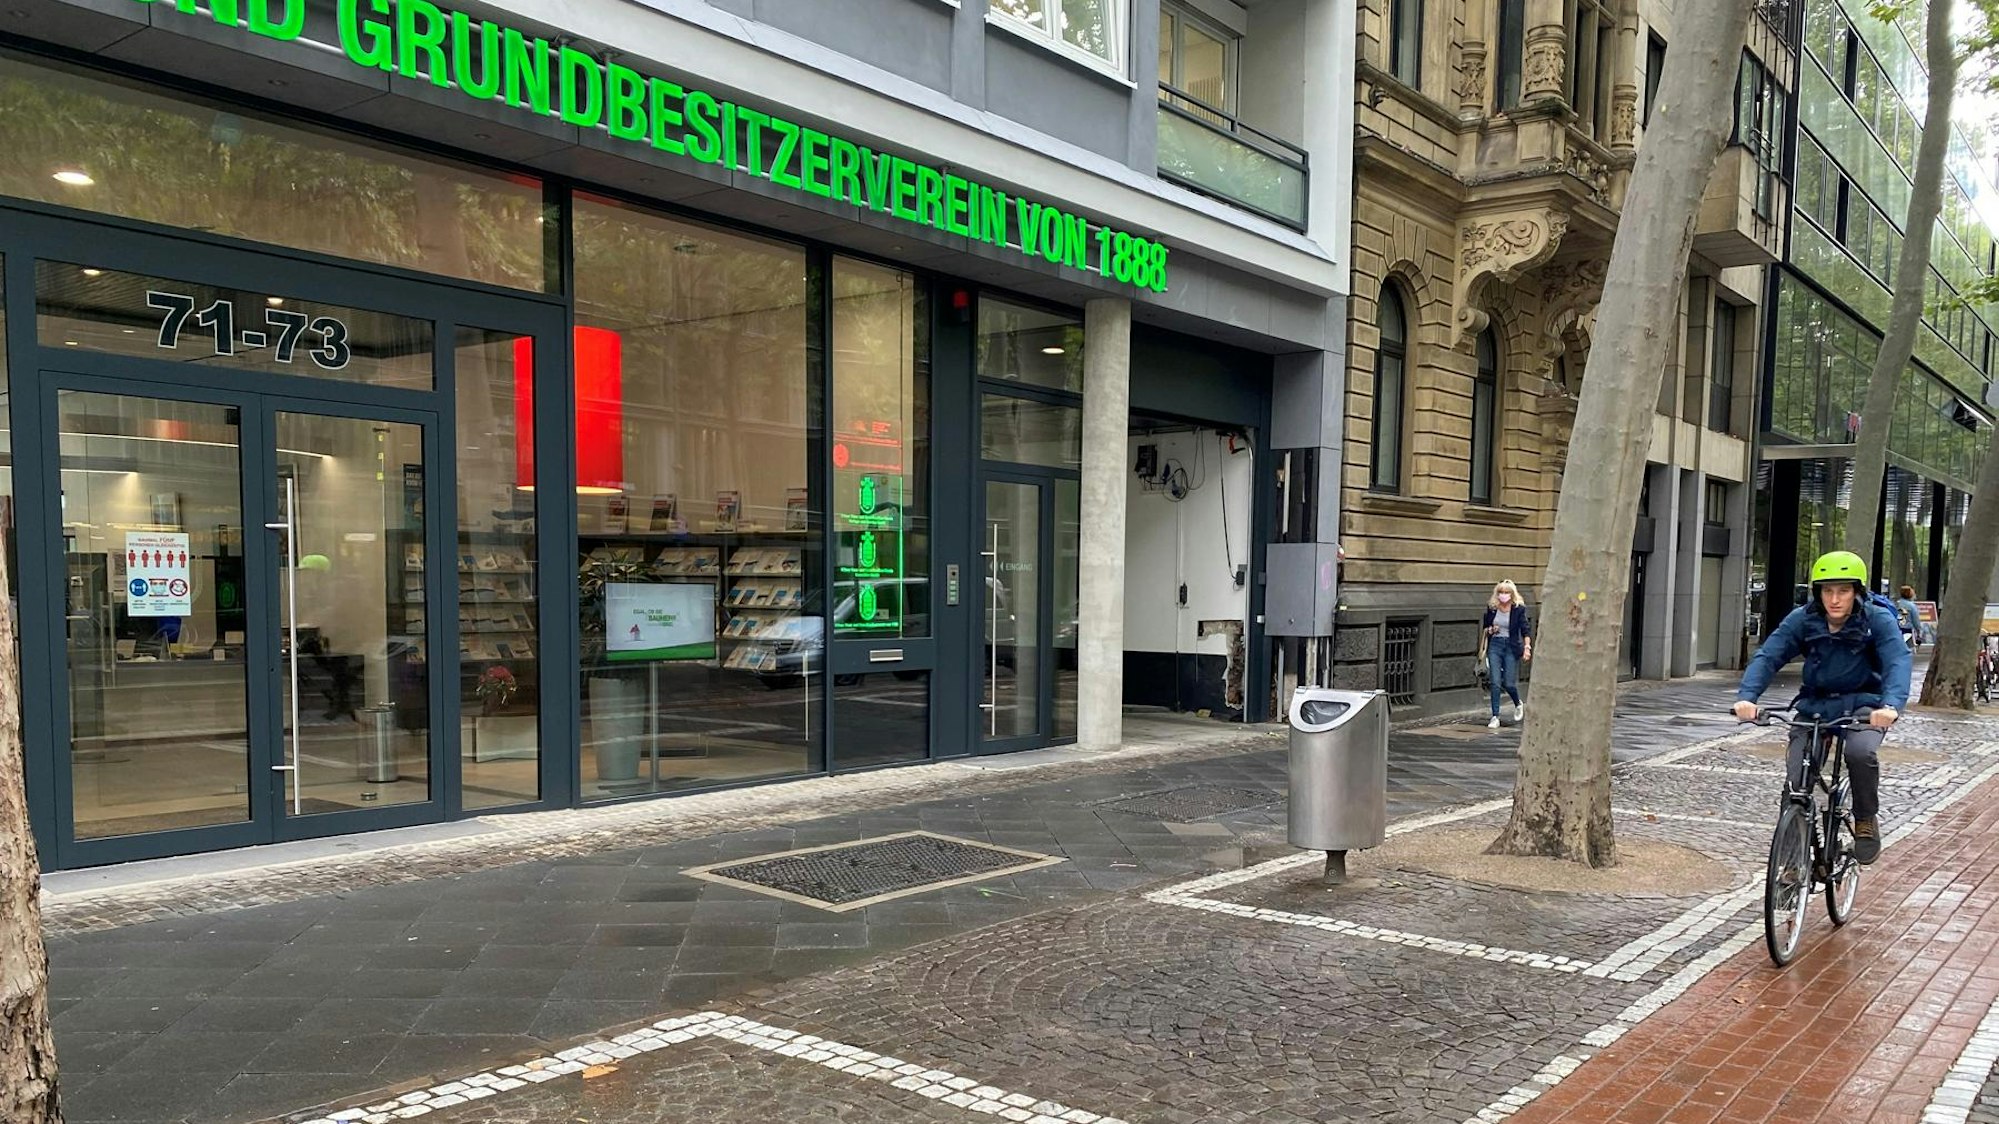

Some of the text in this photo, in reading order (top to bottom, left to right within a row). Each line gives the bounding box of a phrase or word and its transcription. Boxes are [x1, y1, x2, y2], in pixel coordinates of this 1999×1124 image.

[338, 0, 1007, 248] GRUNDBESITZERVEREIN
[1015, 196, 1087, 271] VON
[1095, 226, 1168, 293] 1888
[146, 290, 351, 370] 71-73
